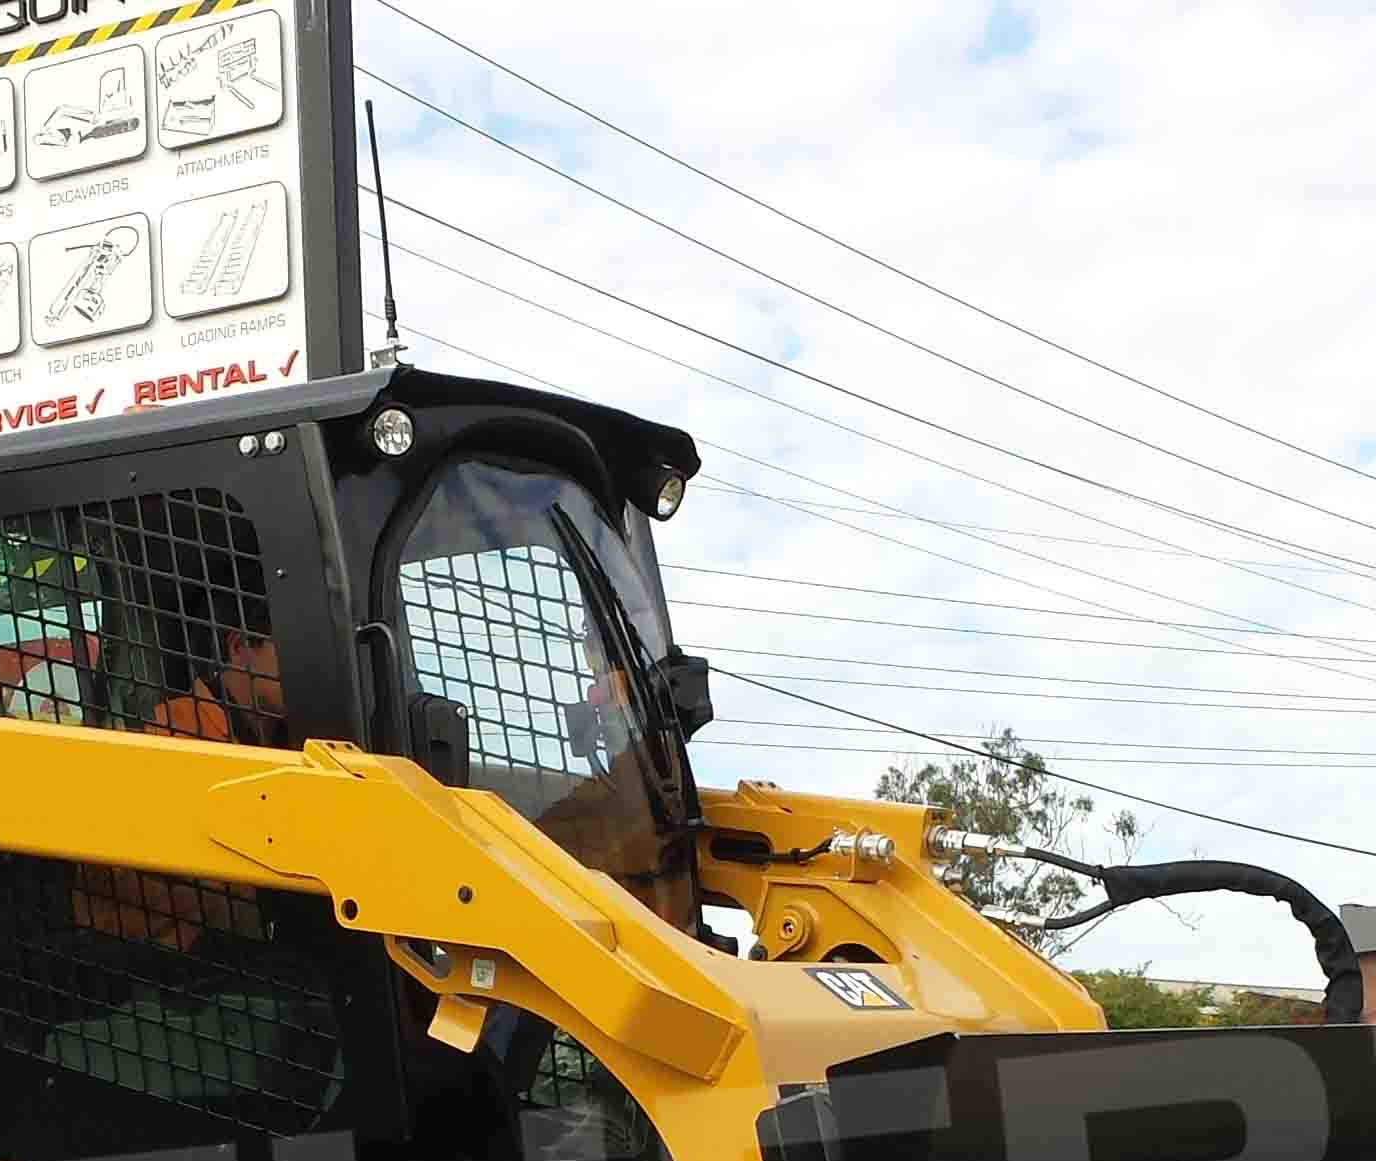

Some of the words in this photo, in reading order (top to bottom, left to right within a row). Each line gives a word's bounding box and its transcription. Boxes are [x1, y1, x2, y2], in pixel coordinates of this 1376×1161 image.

[176, 144, 270, 177] ATTACHMENTS
[49, 177, 129, 207] EXCAVATORS
[180, 324, 237, 348] LOADING
[240, 313, 286, 335] RAMPS
[47, 358, 70, 377] 12V
[73, 347, 122, 369] GREASE
[126, 341, 154, 360] GUN
[133, 360, 268, 405] RENTAL
[816, 972, 901, 1007] CAT
